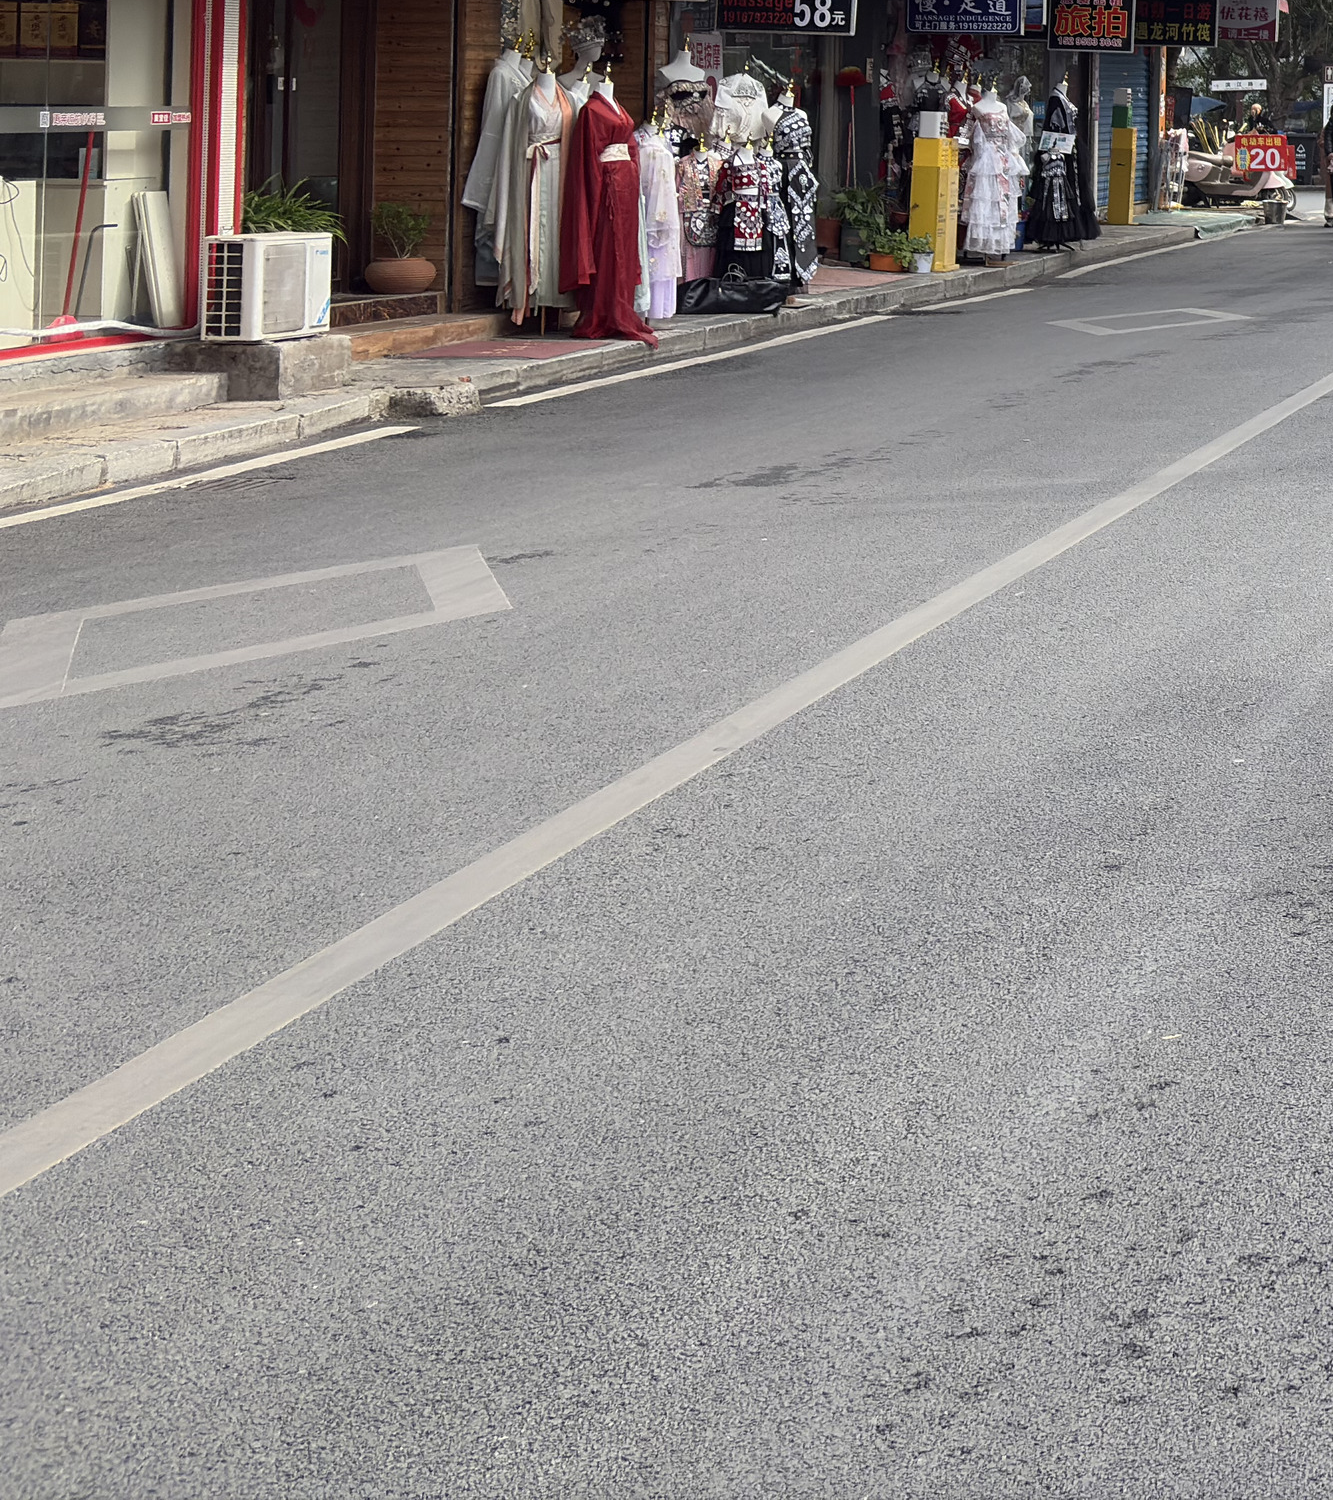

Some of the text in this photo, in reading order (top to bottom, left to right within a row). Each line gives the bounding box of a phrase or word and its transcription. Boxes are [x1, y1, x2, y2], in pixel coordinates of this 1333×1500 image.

[723, 10, 793, 25] 19167923220
[915, 14, 955, 22] MASSAGE
[1054, 3, 1128, 38] 旅拍
[1057, 36, 1075, 46] 152
[1250, 148, 1281, 169] 20
